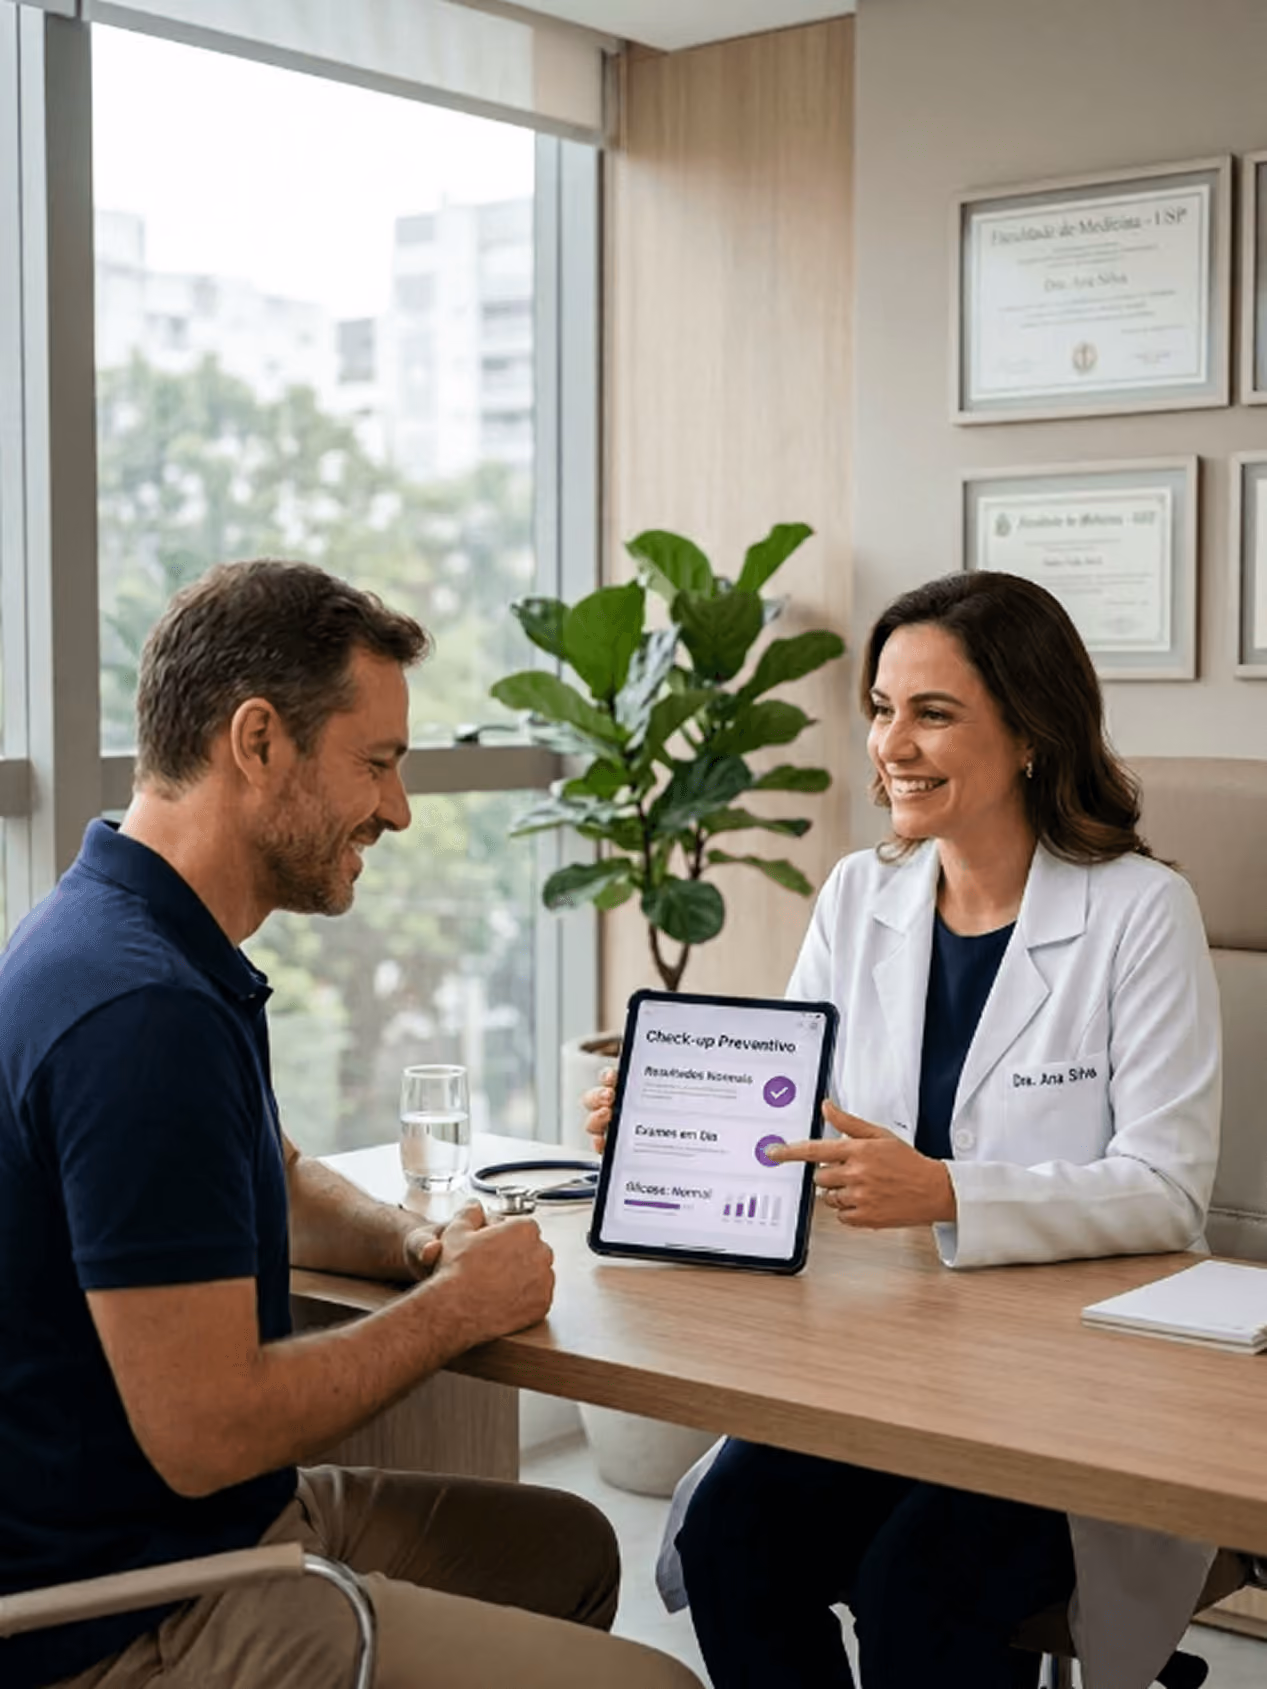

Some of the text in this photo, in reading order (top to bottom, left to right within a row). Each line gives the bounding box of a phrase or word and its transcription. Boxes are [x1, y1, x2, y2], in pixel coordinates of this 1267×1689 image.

[646, 1030, 796, 1054] Check-up Preventivo
[1040, 1072, 1063, 1085] Ana
[635, 1124, 718, 1141] Exames em Dia
[672, 1186, 712, 1199] Normal
